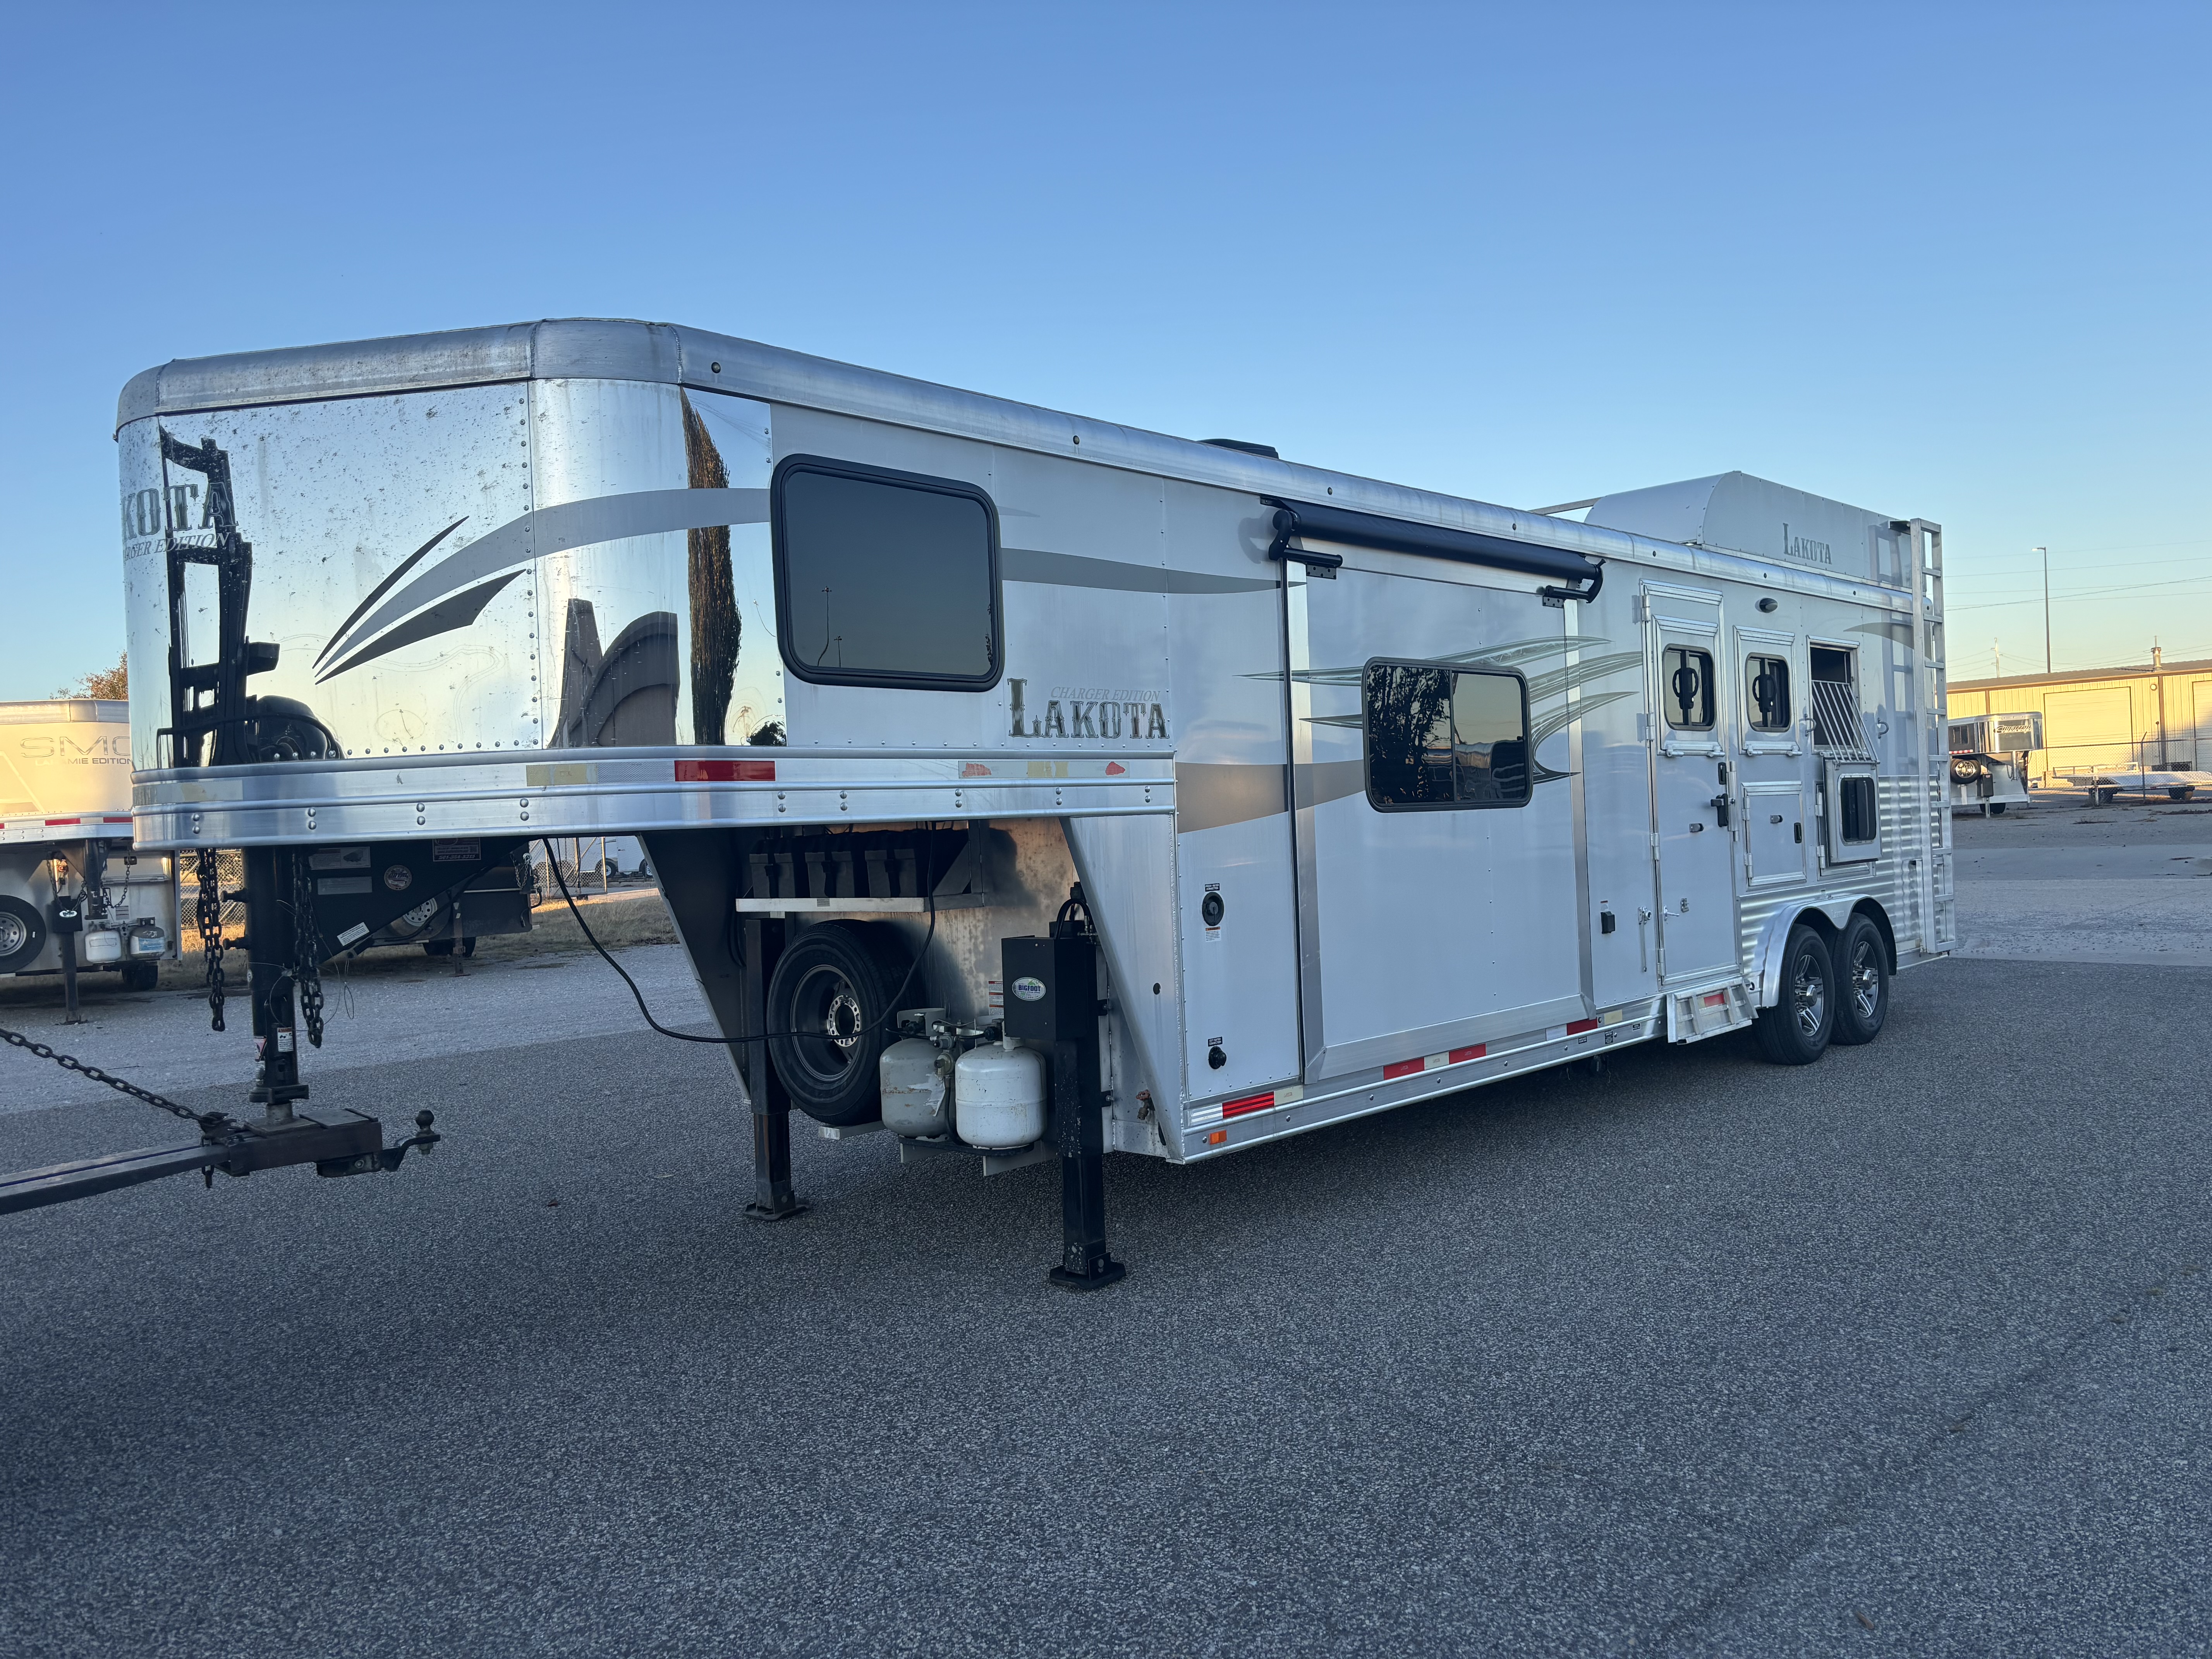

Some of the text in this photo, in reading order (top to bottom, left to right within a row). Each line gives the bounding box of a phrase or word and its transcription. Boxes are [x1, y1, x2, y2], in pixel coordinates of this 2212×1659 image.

[154, 532, 231, 553] EDITION
[1783, 523, 1832, 565] LAKOTA
[1006, 678, 1170, 739] LAKOTA
[1051, 686, 1161, 701] CHARGER EDITION
